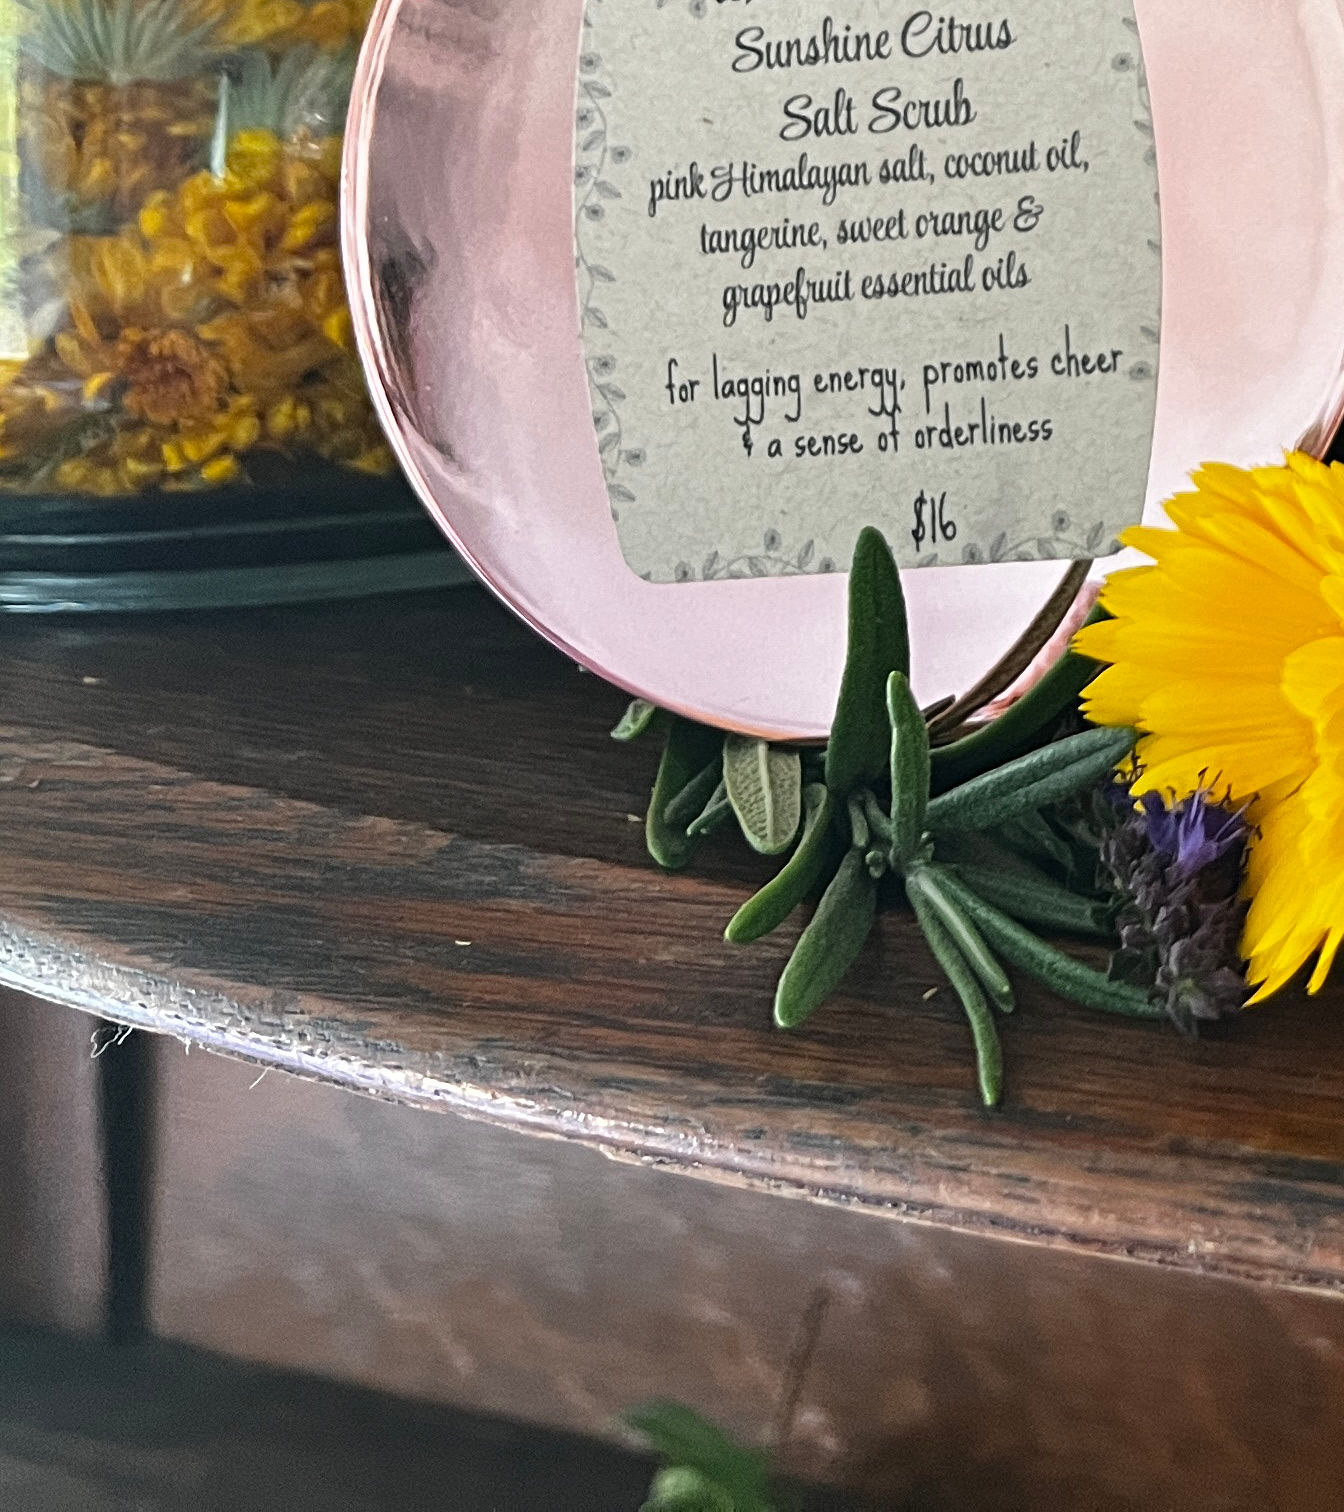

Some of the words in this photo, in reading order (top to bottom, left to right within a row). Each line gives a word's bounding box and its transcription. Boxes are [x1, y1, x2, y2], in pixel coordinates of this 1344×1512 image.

[731, 17, 892, 72] Sunshine
[900, 11, 1017, 58] Citrus
[779, 89, 859, 140] Salt
[868, 80, 977, 134] Scrub
[649, 163, 705, 216] pink
[710, 158, 871, 205] Himalayan
[878, 148, 934, 185] salt,
[944, 143, 1040, 179] coconut
[1046, 131, 1090, 173] oil,
[700, 217, 829, 268] tangerine,
[837, 208, 911, 245] sweet
[915, 204, 1004, 247] orange
[1013, 196, 1045, 232] &
[722, 268, 855, 327] grapefruit
[861, 259, 976, 298] essential
[982, 253, 1032, 291] oils
[665, 359, 700, 405] for
[713, 354, 801, 425] lagging
[813, 362, 906, 417] energy,
[923, 334, 1039, 413] promotes
[1051, 324, 1124, 378] cheer
[767, 434, 782, 458] a
[795, 432, 864, 458] sense
[877, 407, 901, 454] of
[914, 397, 1053, 450] orderliness
[911, 489, 958, 552] $16
